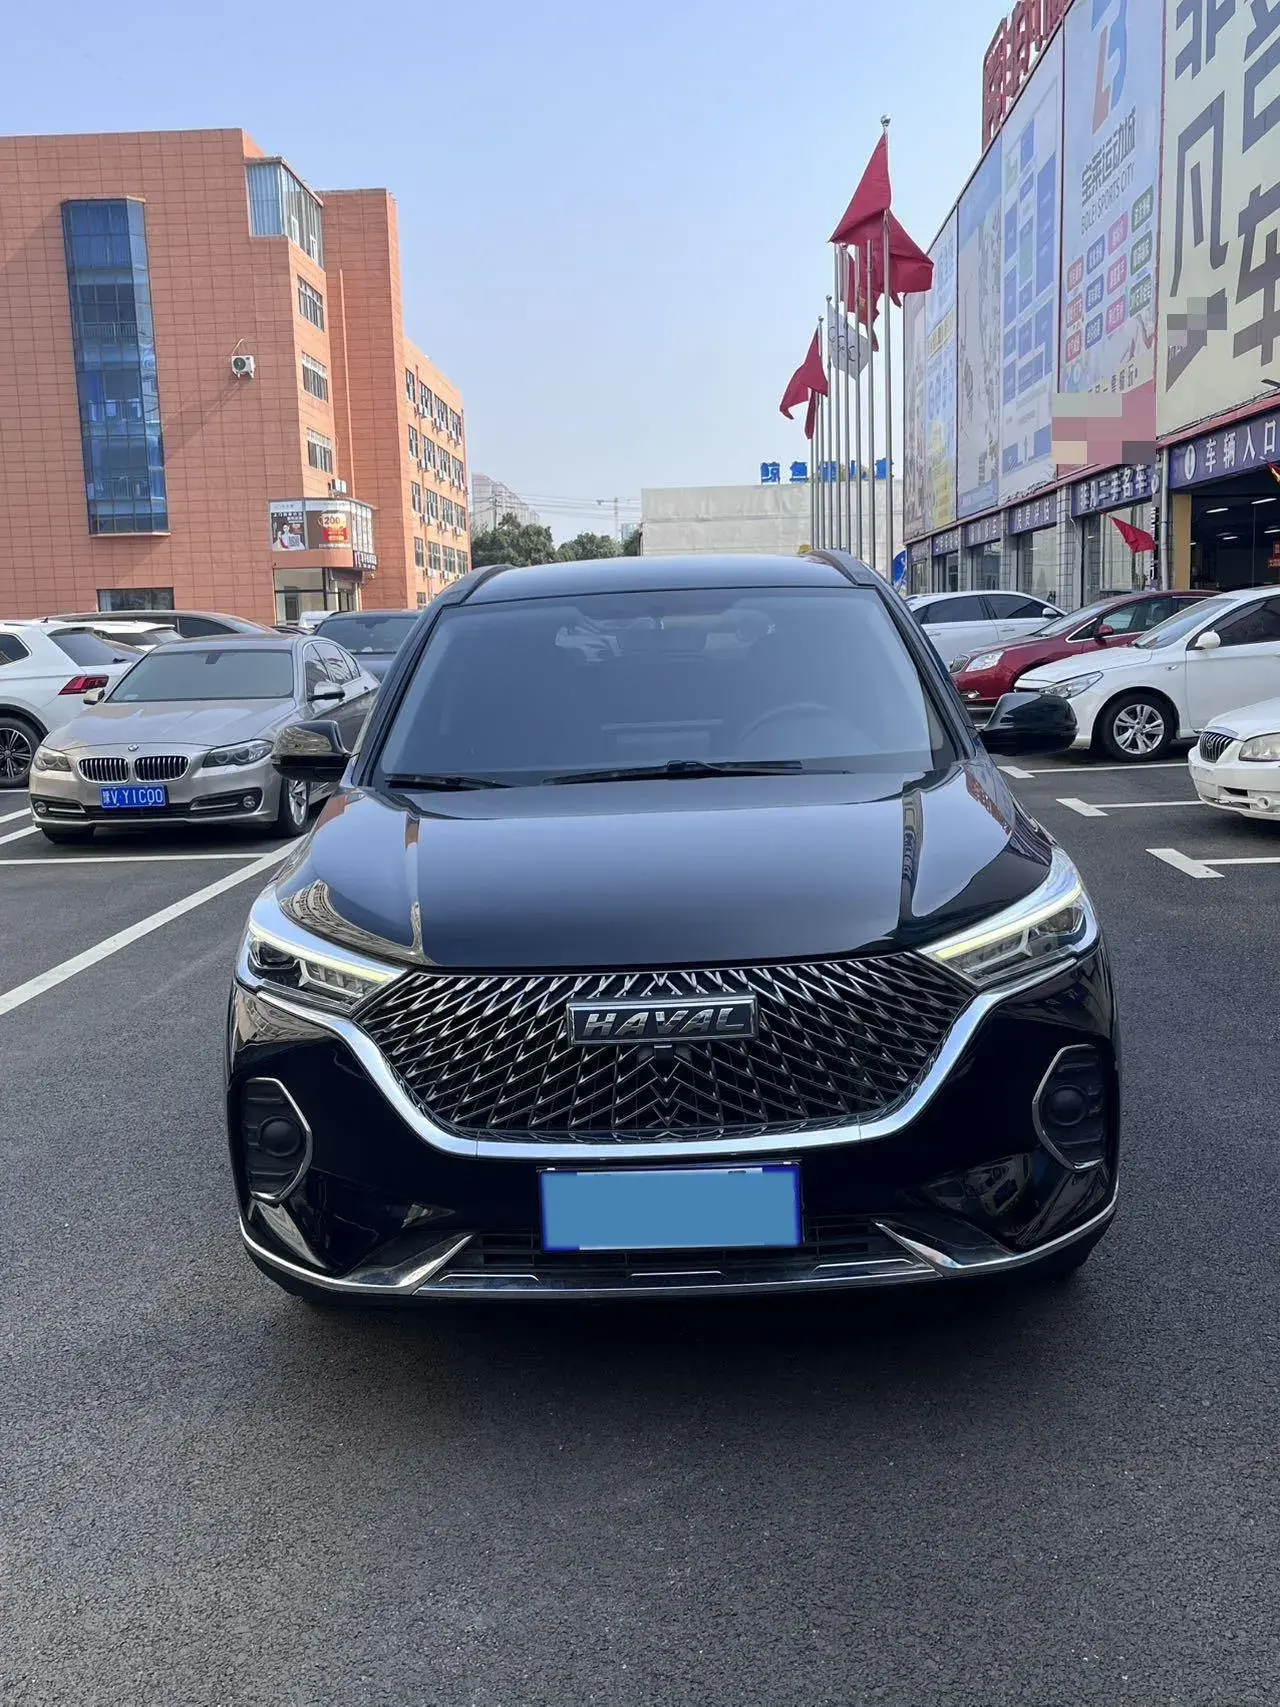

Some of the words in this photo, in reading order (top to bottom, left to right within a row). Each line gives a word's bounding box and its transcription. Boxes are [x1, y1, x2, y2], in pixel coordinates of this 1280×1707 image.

[1097, 177, 1120, 218] SPORTS
[1121, 161, 1136, 193] CITY
[1205, 419, 1276, 473] 车辆入口
[582, 1007, 745, 1036] HAVAL
